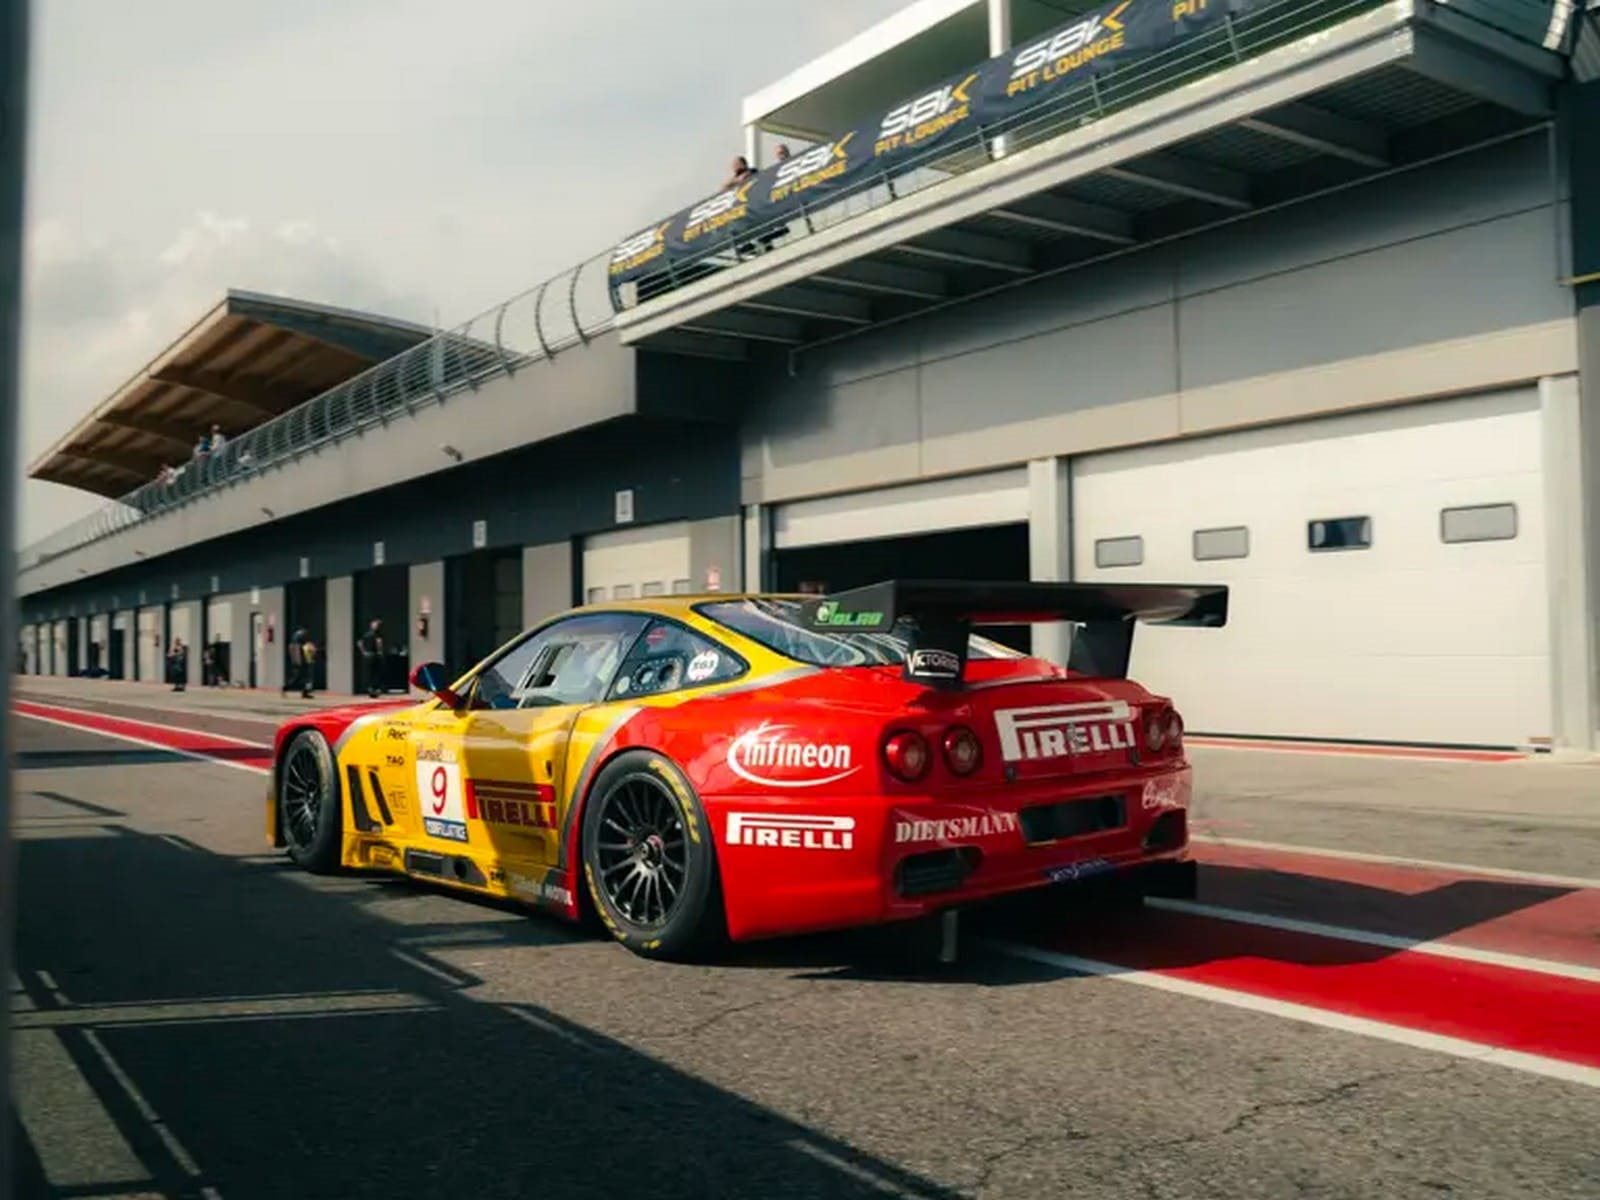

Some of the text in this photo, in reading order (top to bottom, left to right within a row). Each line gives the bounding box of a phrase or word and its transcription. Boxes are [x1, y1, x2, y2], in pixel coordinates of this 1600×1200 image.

[1007, 31, 1125, 97] PIT LOUNGE
[1010, 0, 1132, 79] SBK
[875, 104, 969, 156] PIT LOUNGE
[879, 72, 979, 138] SBK
[772, 131, 856, 188] SBK
[792, 160, 847, 193] LOUNGE
[687, 177, 757, 228] SBK
[906, 651, 960, 676] VICTORIA
[993, 700, 1138, 762] PIRELLI
[431, 766, 447, 815] 9
[465, 778, 557, 830] PIRELLI
[725, 811, 856, 850] PIRELLI
[896, 811, 1018, 843] DIETSMANN
